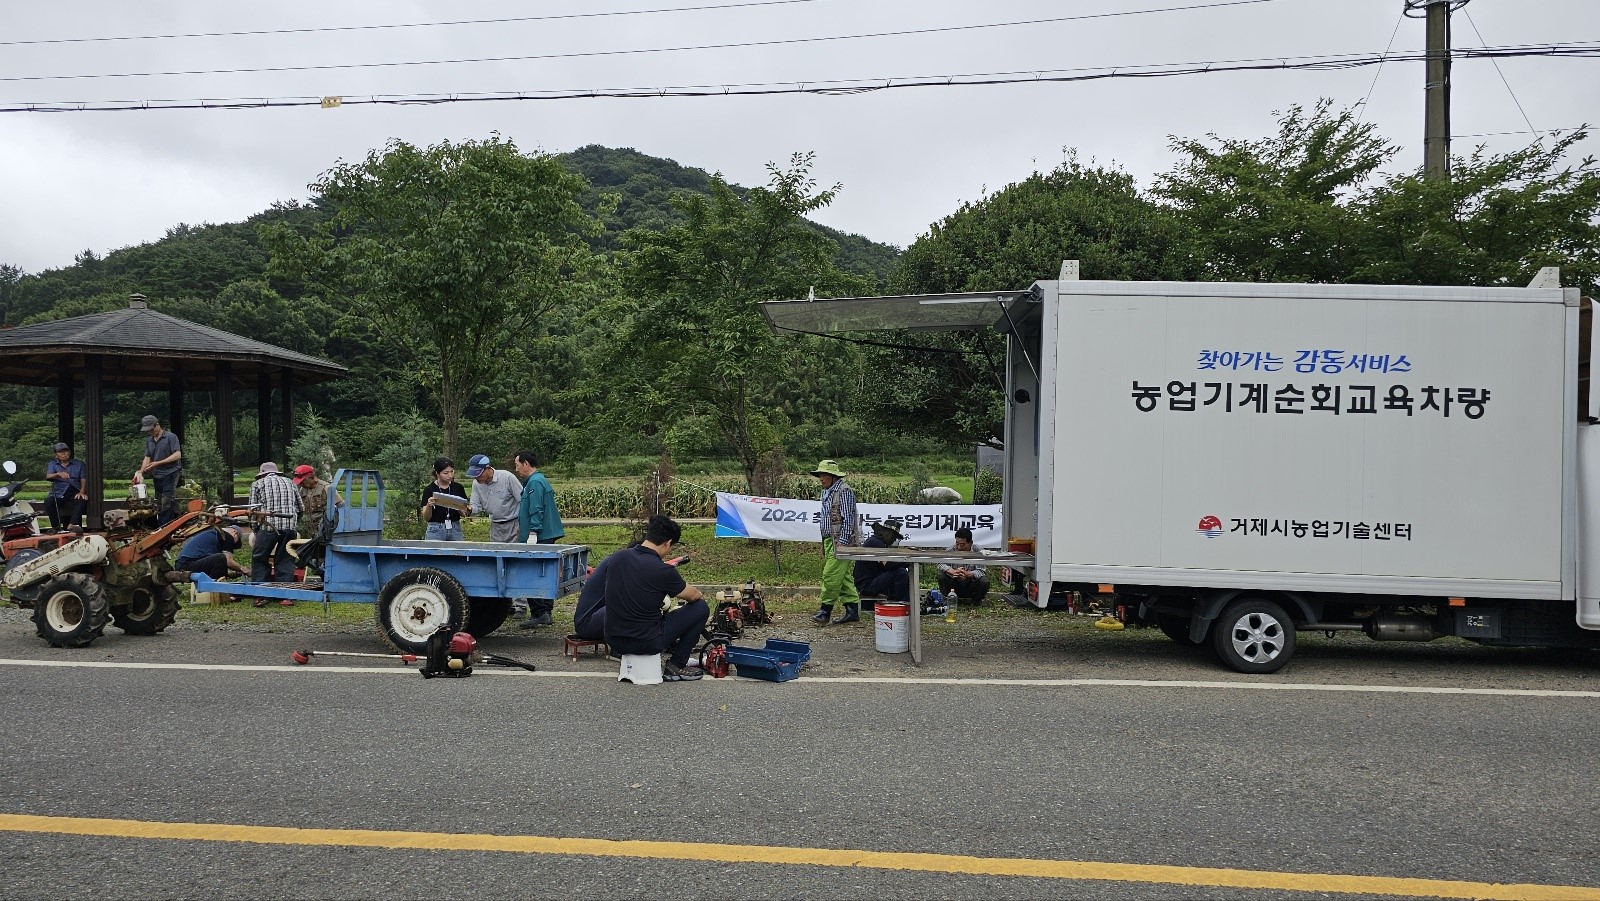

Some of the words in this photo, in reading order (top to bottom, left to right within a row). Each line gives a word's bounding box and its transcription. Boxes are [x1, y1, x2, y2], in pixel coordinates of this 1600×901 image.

[1197, 350, 1284, 372] 찾아가는
[1293, 349, 1412, 374] 감동서비스
[1132, 381, 1490, 419] 농업기계순회교육차량
[761, 507, 808, 522] 2024
[888, 514, 995, 531] 농업기계교육
[1231, 519, 1411, 540] 거제시농업기술센터
